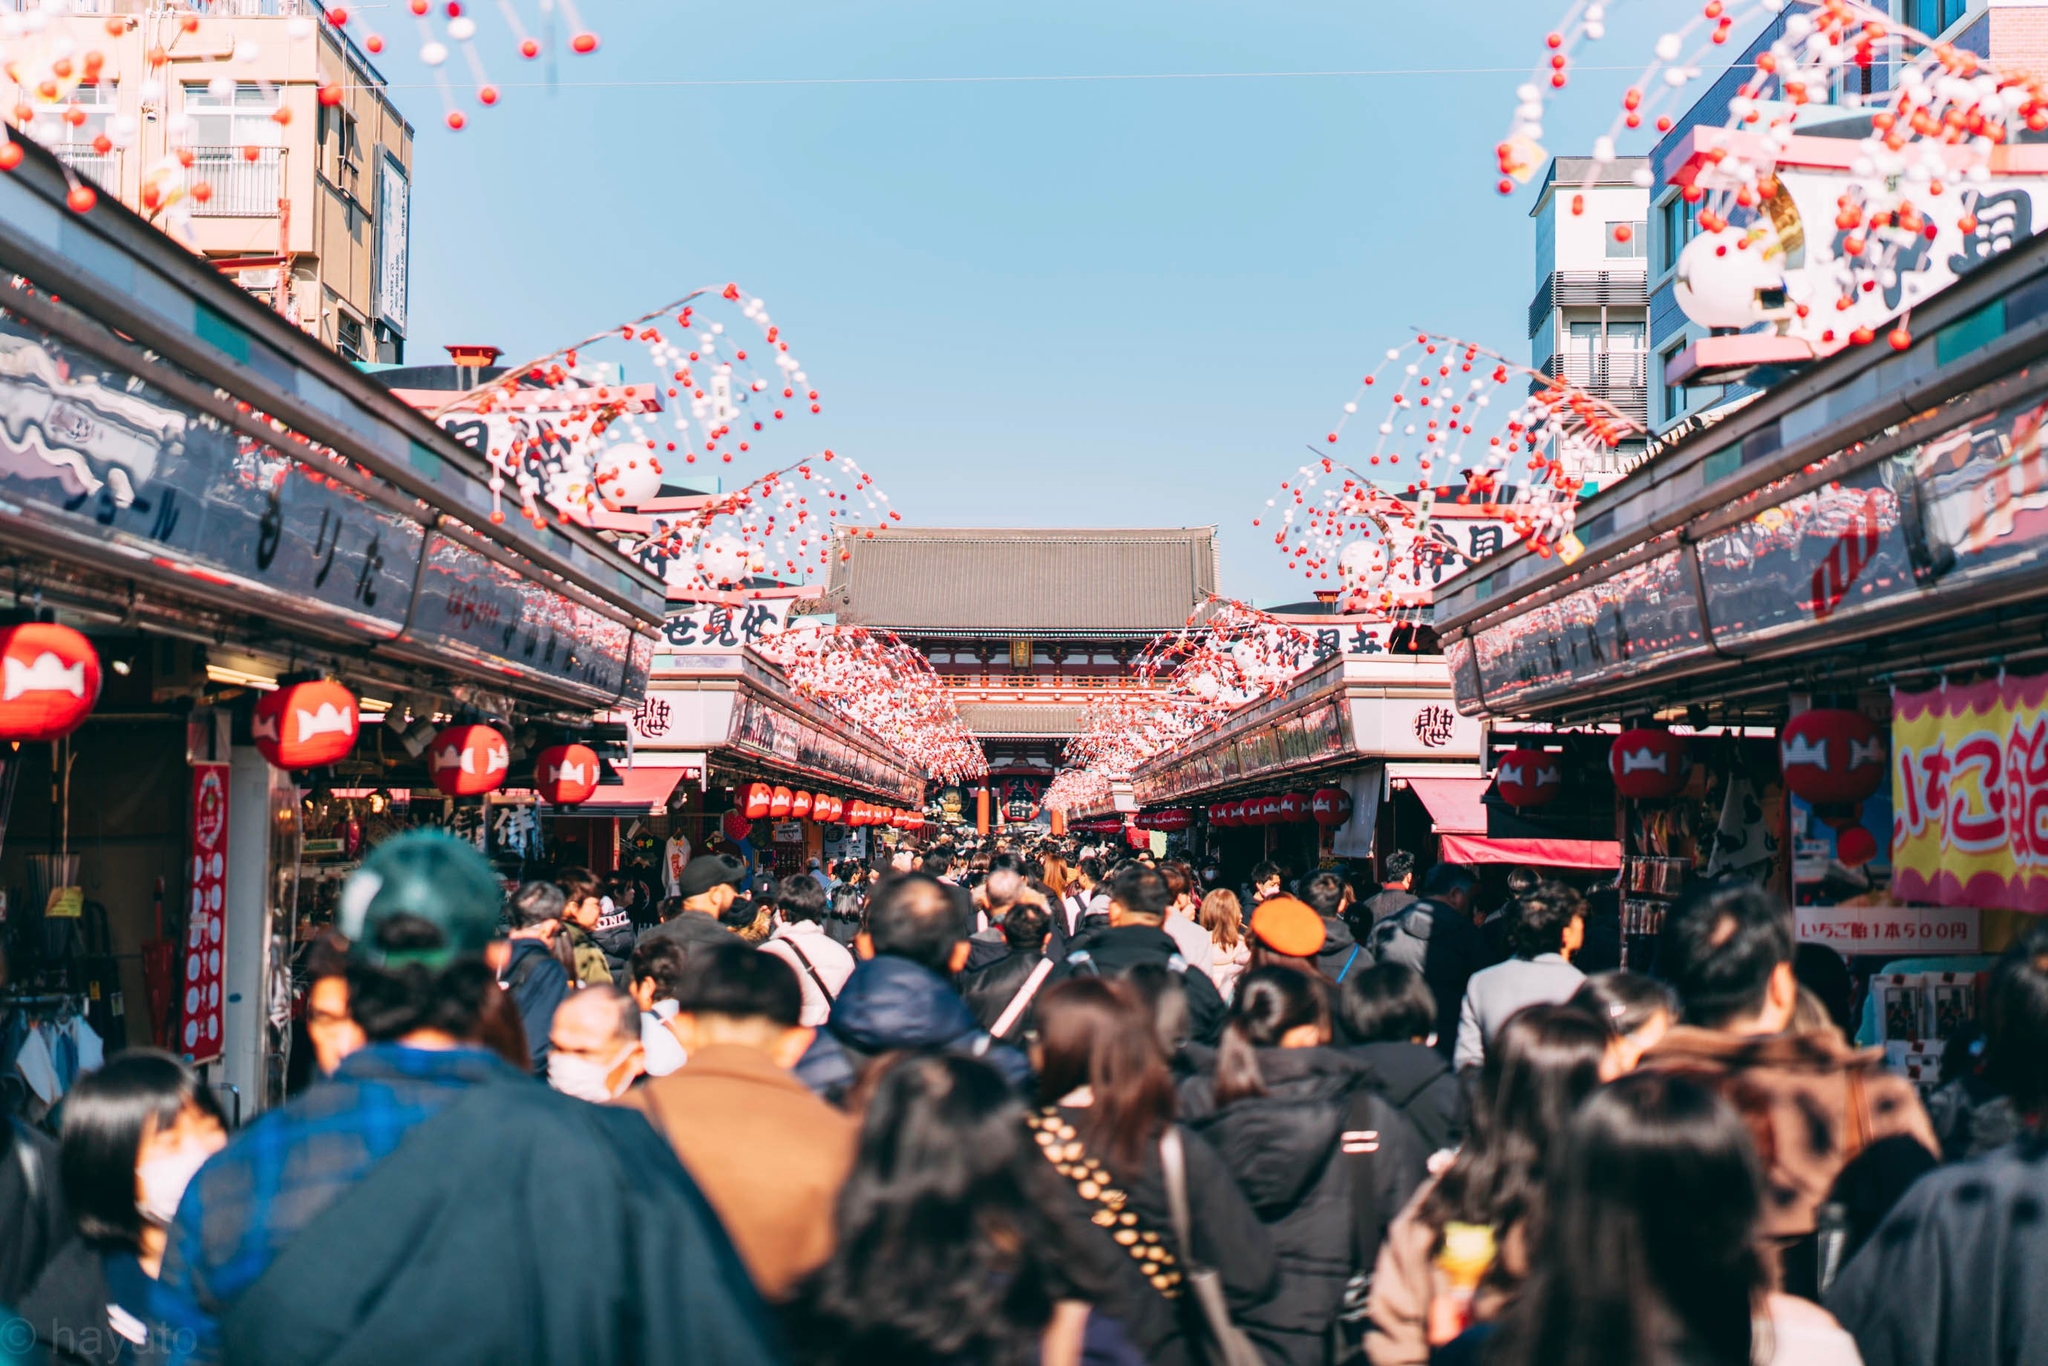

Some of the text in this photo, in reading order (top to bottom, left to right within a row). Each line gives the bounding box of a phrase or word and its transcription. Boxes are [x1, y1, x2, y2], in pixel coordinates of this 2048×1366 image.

[1801, 921, 1968, 939] いちご飴1本500円
